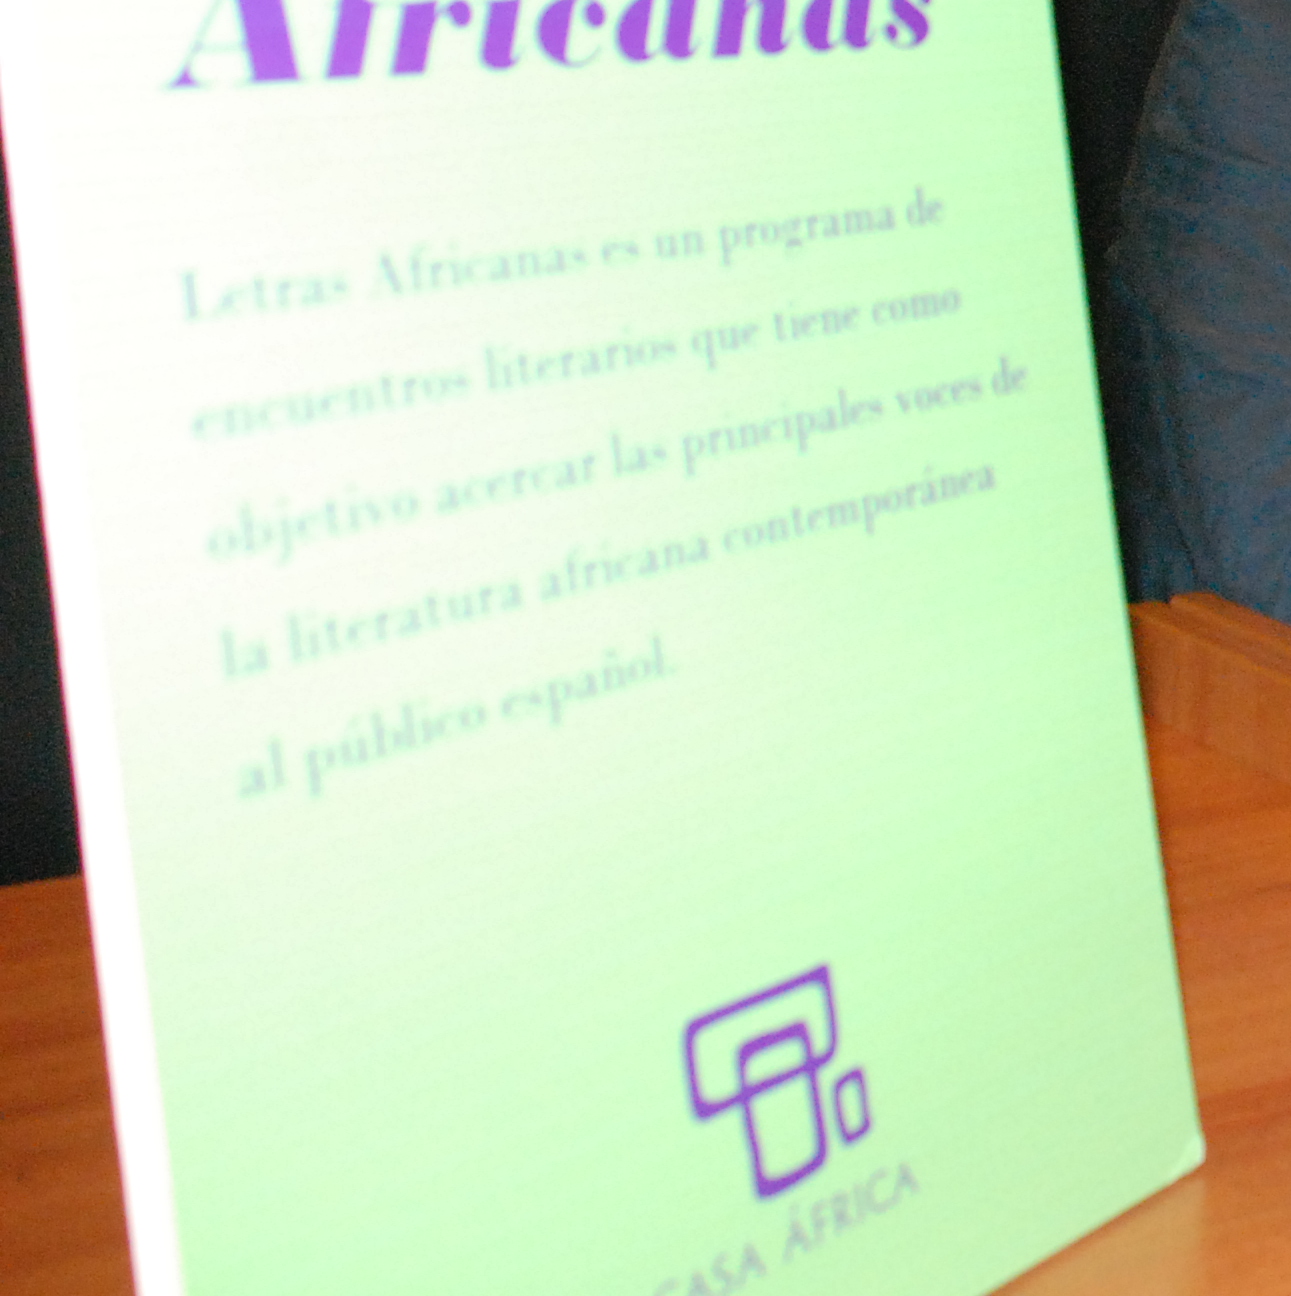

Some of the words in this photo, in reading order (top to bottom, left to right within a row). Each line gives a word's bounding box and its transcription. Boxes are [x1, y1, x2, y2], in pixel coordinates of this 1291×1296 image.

[180, 267, 350, 324] Letras
[370, 238, 588, 301] Africanas
[600, 235, 641, 265] es
[654, 226, 706, 260] un
[719, 204, 897, 265] programa
[905, 187, 944, 232] de
[192, 365, 469, 442] encuentros
[483, 334, 678, 393] literarios
[690, 318, 760, 370] que
[773, 292, 859, 344] tiene
[872, 283, 962, 327] como
[205, 481, 420, 565] objetivo
[436, 452, 598, 513] acercar
[610, 431, 669, 478] las
[682, 388, 884, 477] principales
[895, 371, 983, 418] voces
[991, 356, 1028, 396] de
[220, 627, 269, 679] la
[288, 576, 523, 663] literatura
[539, 533, 711, 603] africana
[723, 457, 997, 557] contemporánea
[238, 738, 288, 800] al
[305, 697, 488, 798] público
[782, 1160, 921, 1266] ÁFRICA
